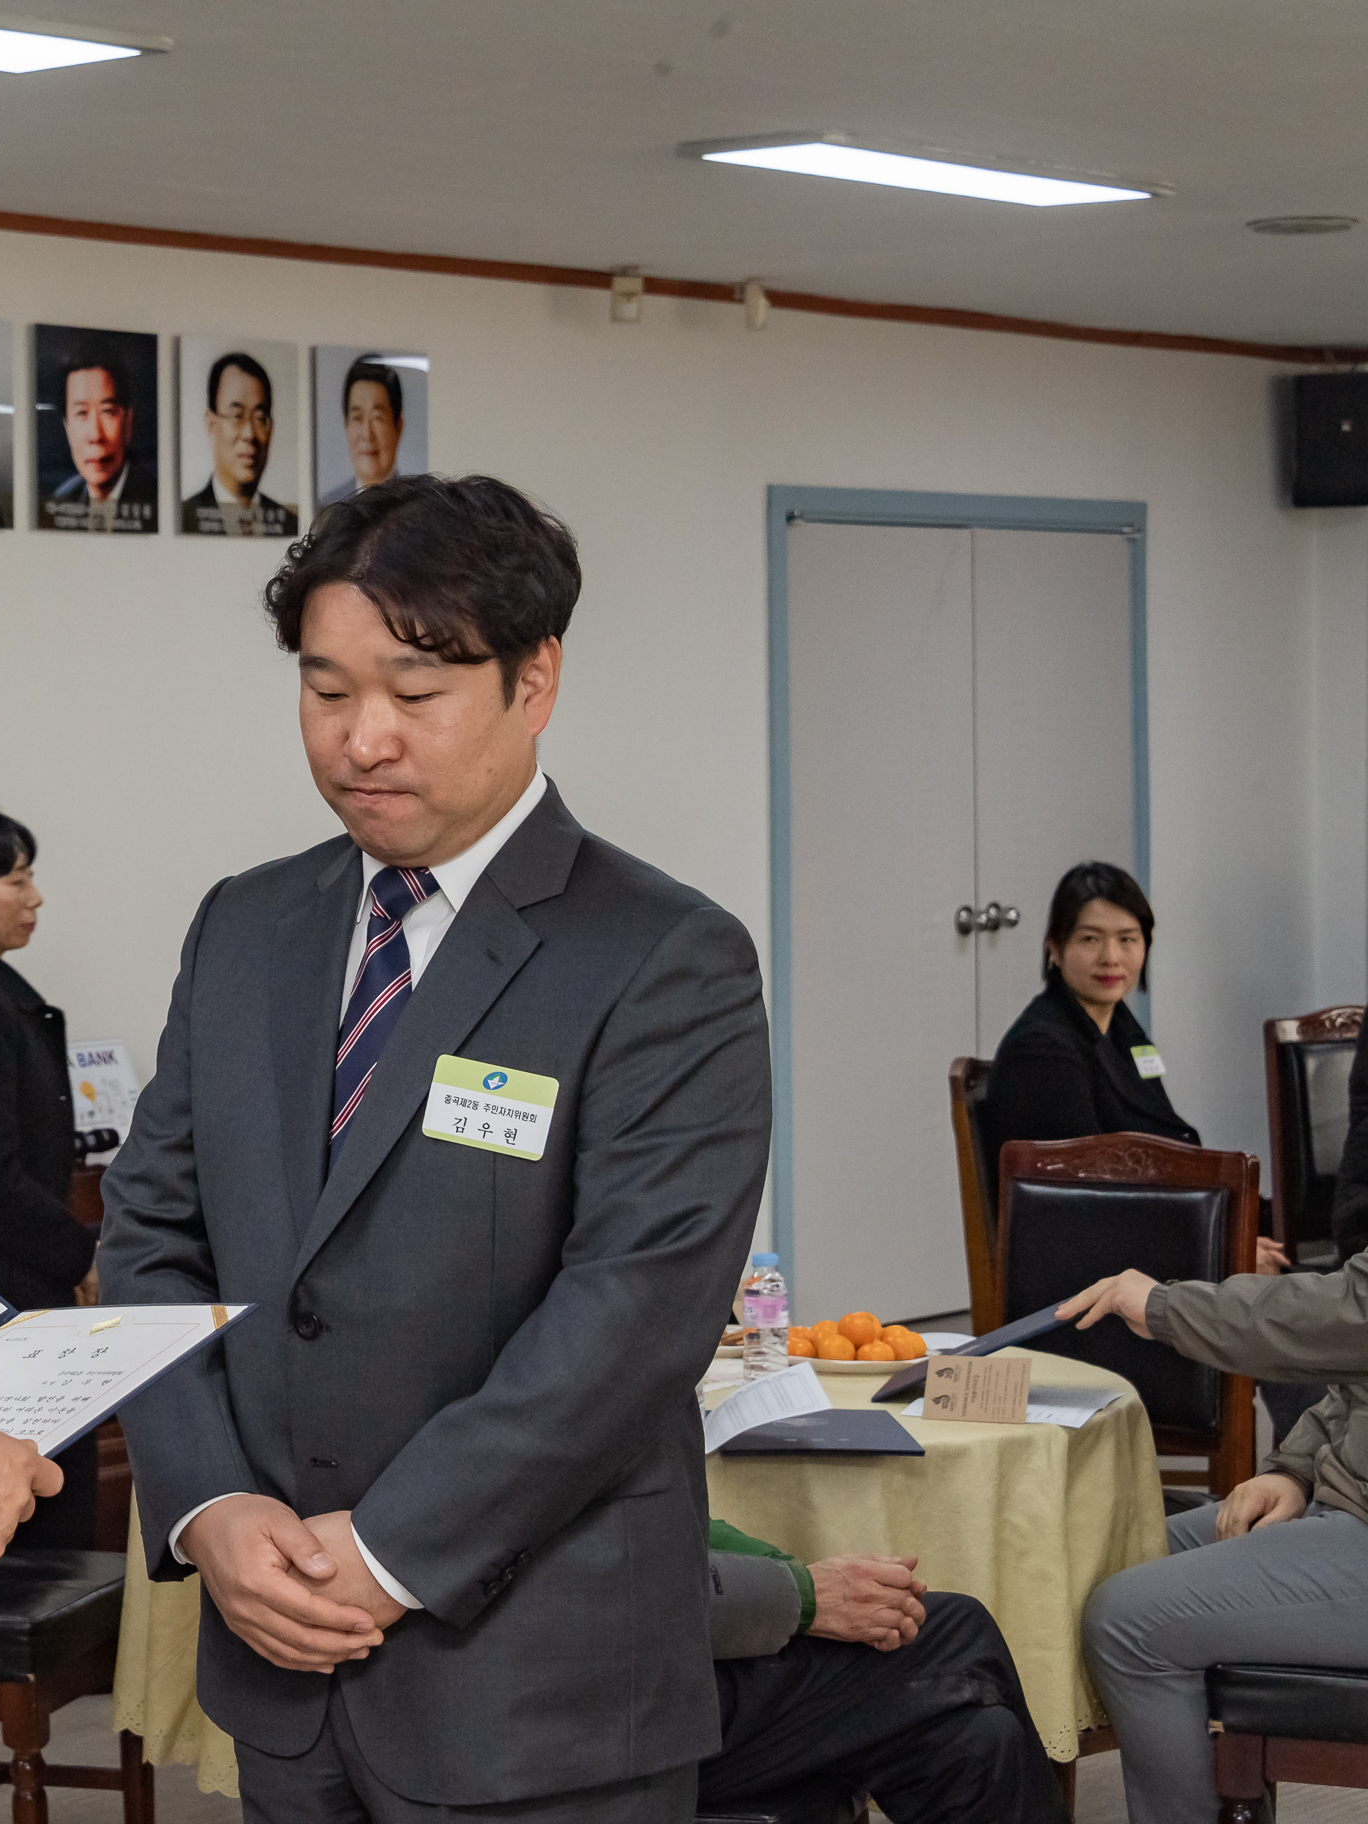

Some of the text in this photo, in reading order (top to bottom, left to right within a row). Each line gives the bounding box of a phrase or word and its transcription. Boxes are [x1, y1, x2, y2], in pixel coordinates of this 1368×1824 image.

[76, 1049, 119, 1068] BANK
[444, 1094, 538, 1123] 중곡제2동 주민자치위원회
